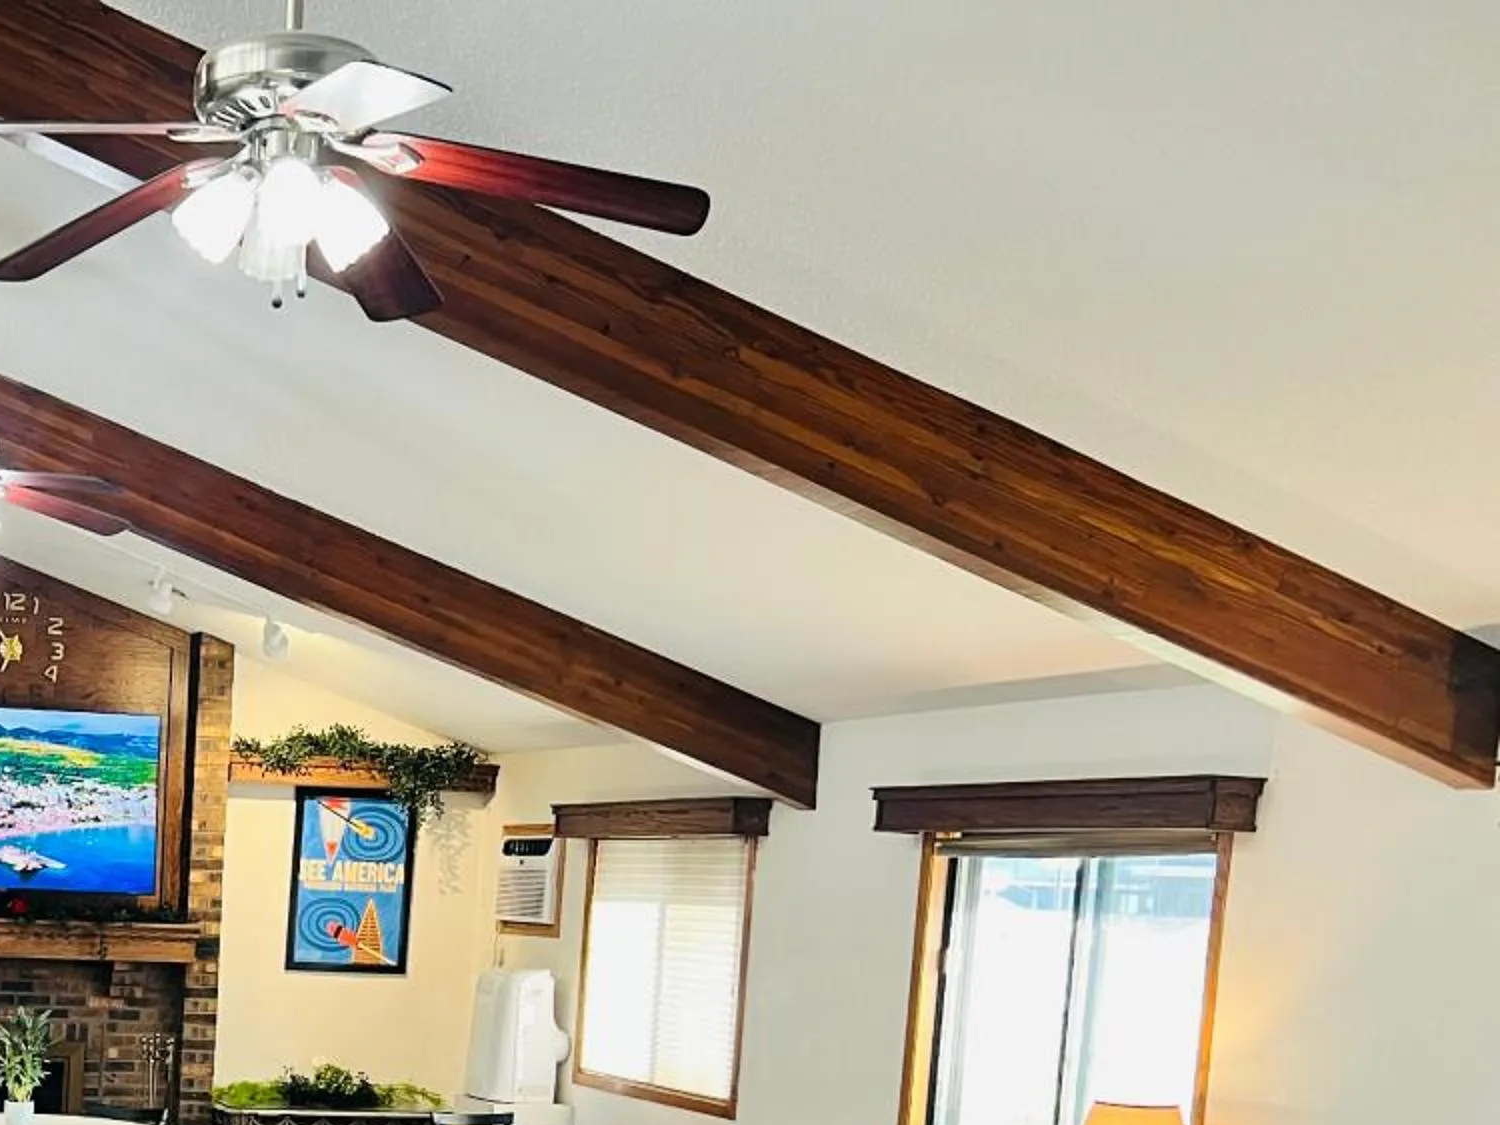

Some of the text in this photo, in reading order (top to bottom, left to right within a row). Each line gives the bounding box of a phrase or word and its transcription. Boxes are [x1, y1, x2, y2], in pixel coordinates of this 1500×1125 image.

[4, 593, 25, 611] 12
[33, 597, 39, 614] 1
[48, 617, 63, 635] 2
[51, 642, 64, 660] 3
[44, 665, 58, 683] 4
